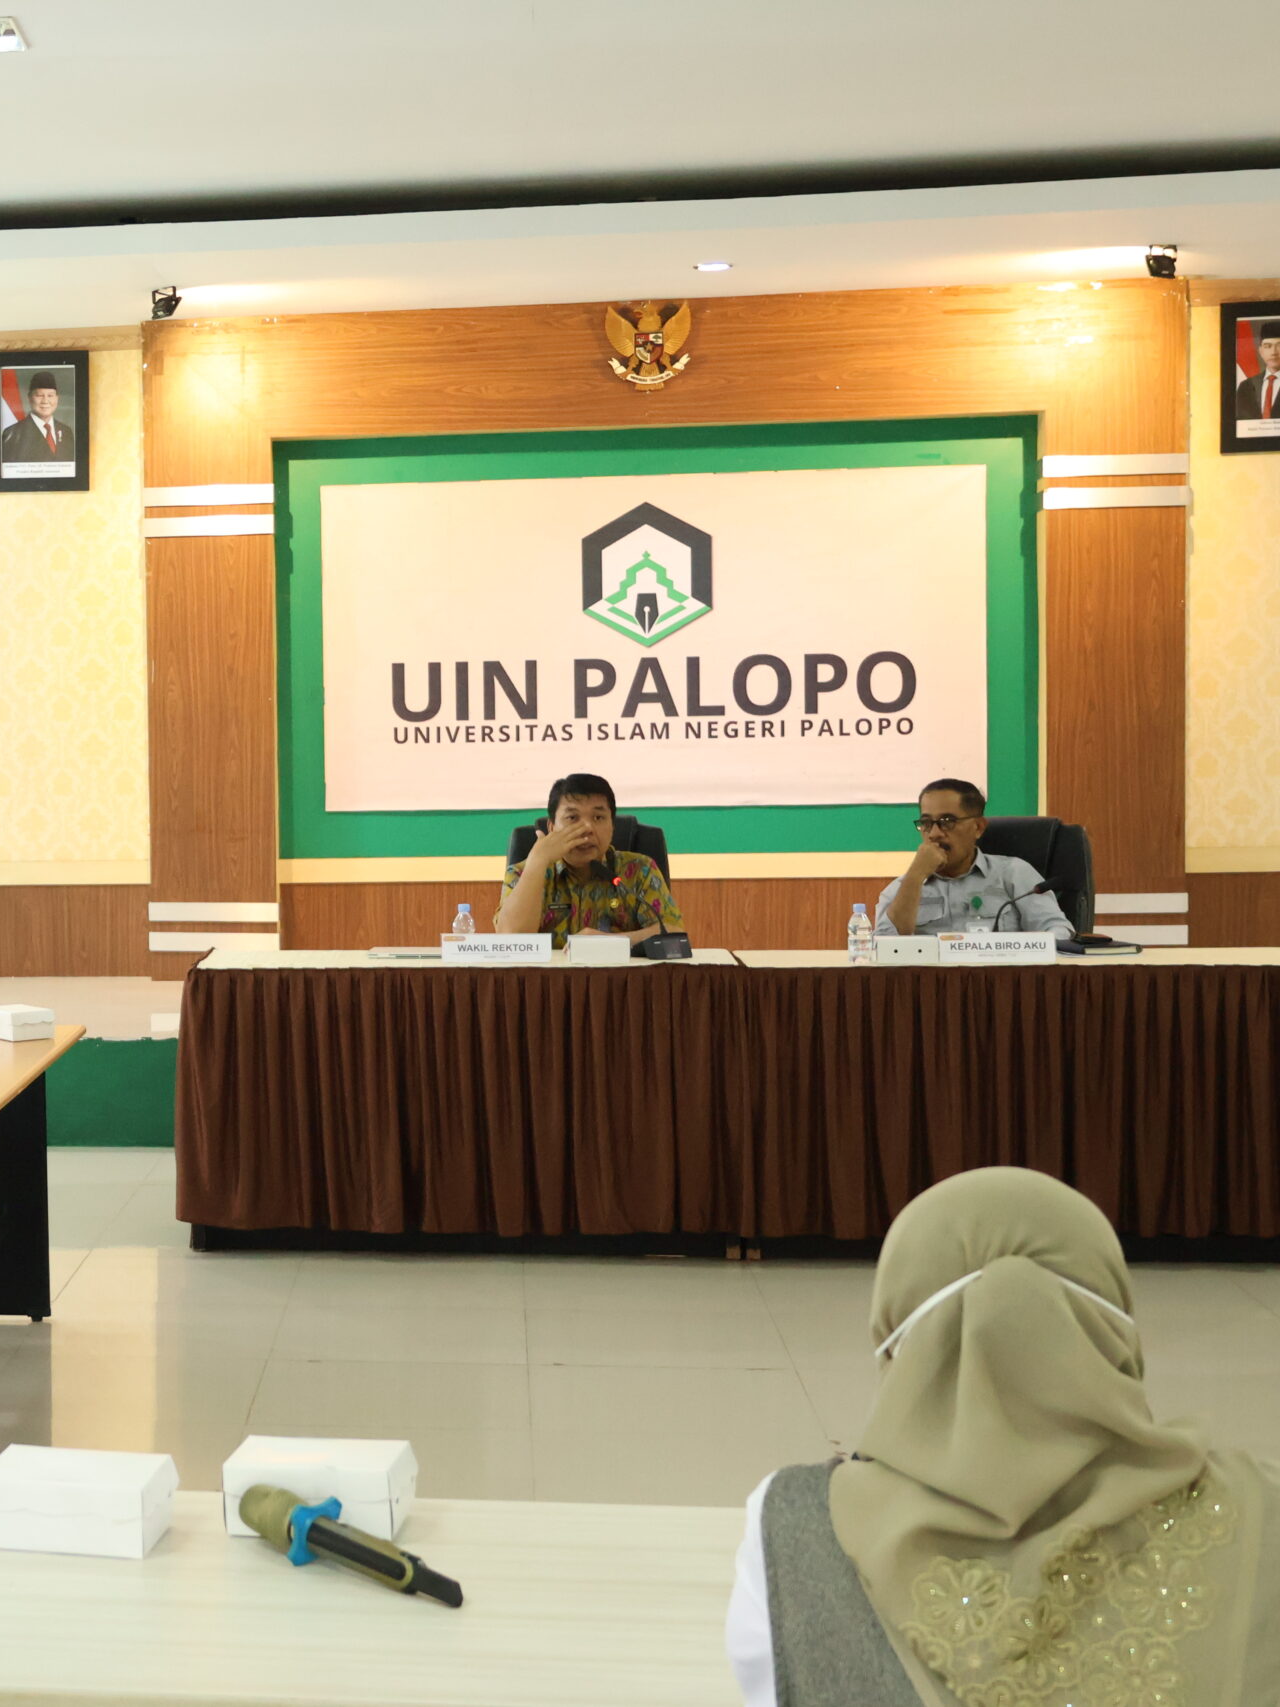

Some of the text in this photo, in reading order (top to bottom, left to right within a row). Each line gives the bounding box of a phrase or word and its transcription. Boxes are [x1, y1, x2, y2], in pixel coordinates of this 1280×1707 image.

[391, 651, 917, 723] UIN PALOPO
[392, 716, 915, 745] UNIVERSITAS ISLAM NEGERI PALOPO
[457, 944, 489, 952] WAKIL
[491, 943, 534, 952] REKTOR
[949, 941, 1047, 951] KEPALA BIRO AKU
